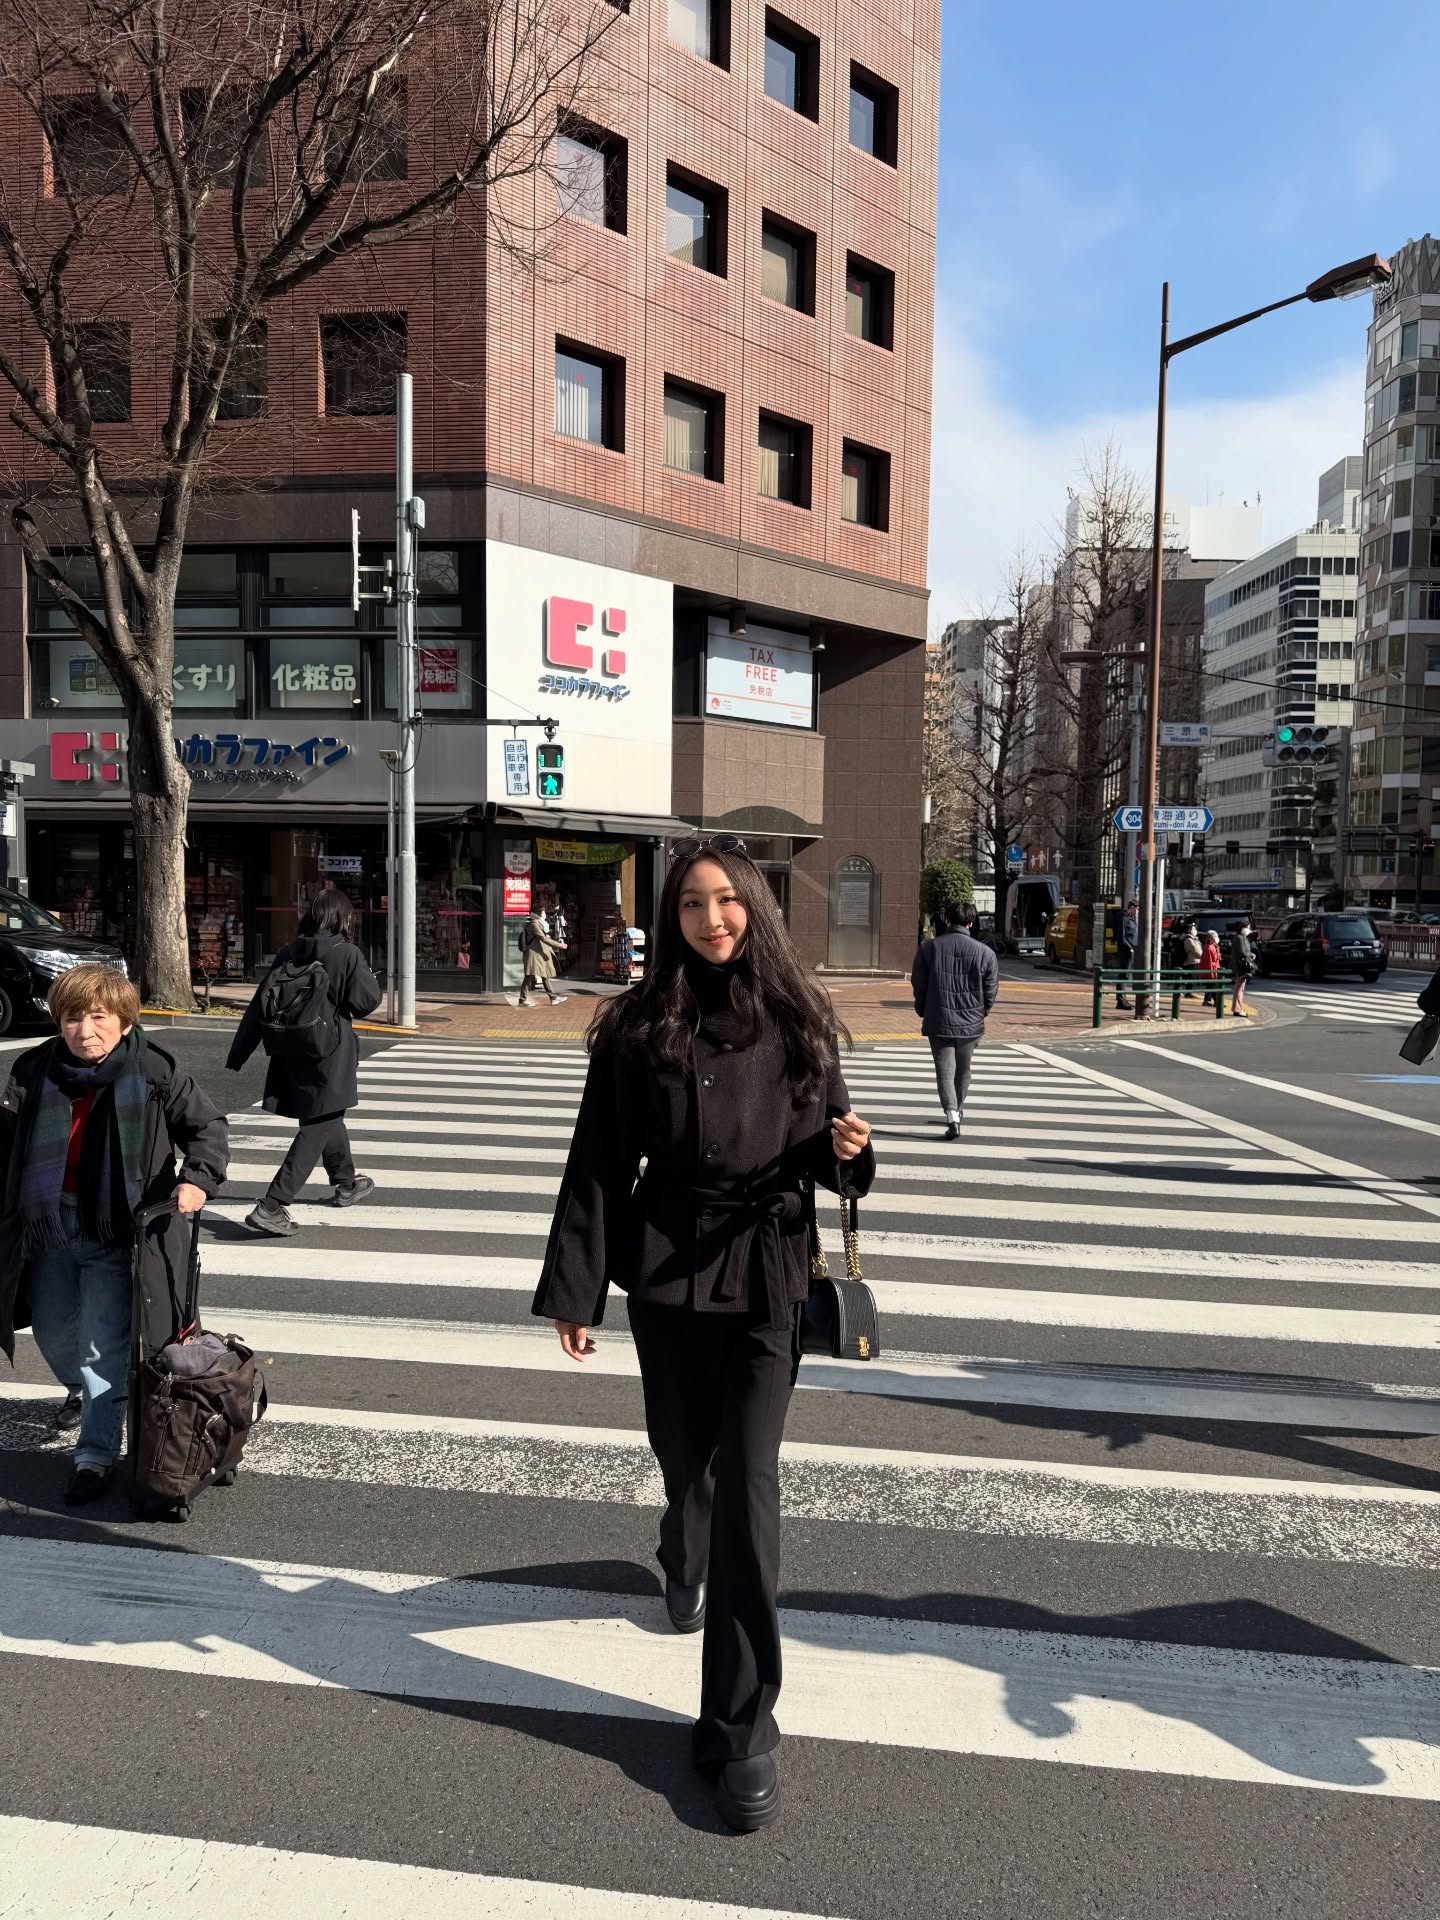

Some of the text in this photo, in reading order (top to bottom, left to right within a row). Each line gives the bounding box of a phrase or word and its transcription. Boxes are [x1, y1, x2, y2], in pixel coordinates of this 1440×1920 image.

[1086, 511, 1180, 525] SUPERHOEL
[749, 647, 774, 665] TAX
[272, 664, 357, 691] 化粧品
[424, 669, 457, 684] 免税店
[745, 664, 777, 682] FREE
[544, 674, 630, 698] ココカラファイン
[749, 684, 773, 697] 免税店
[1165, 726, 1208, 736] 三原橋
[174, 734, 351, 766] カラファイン
